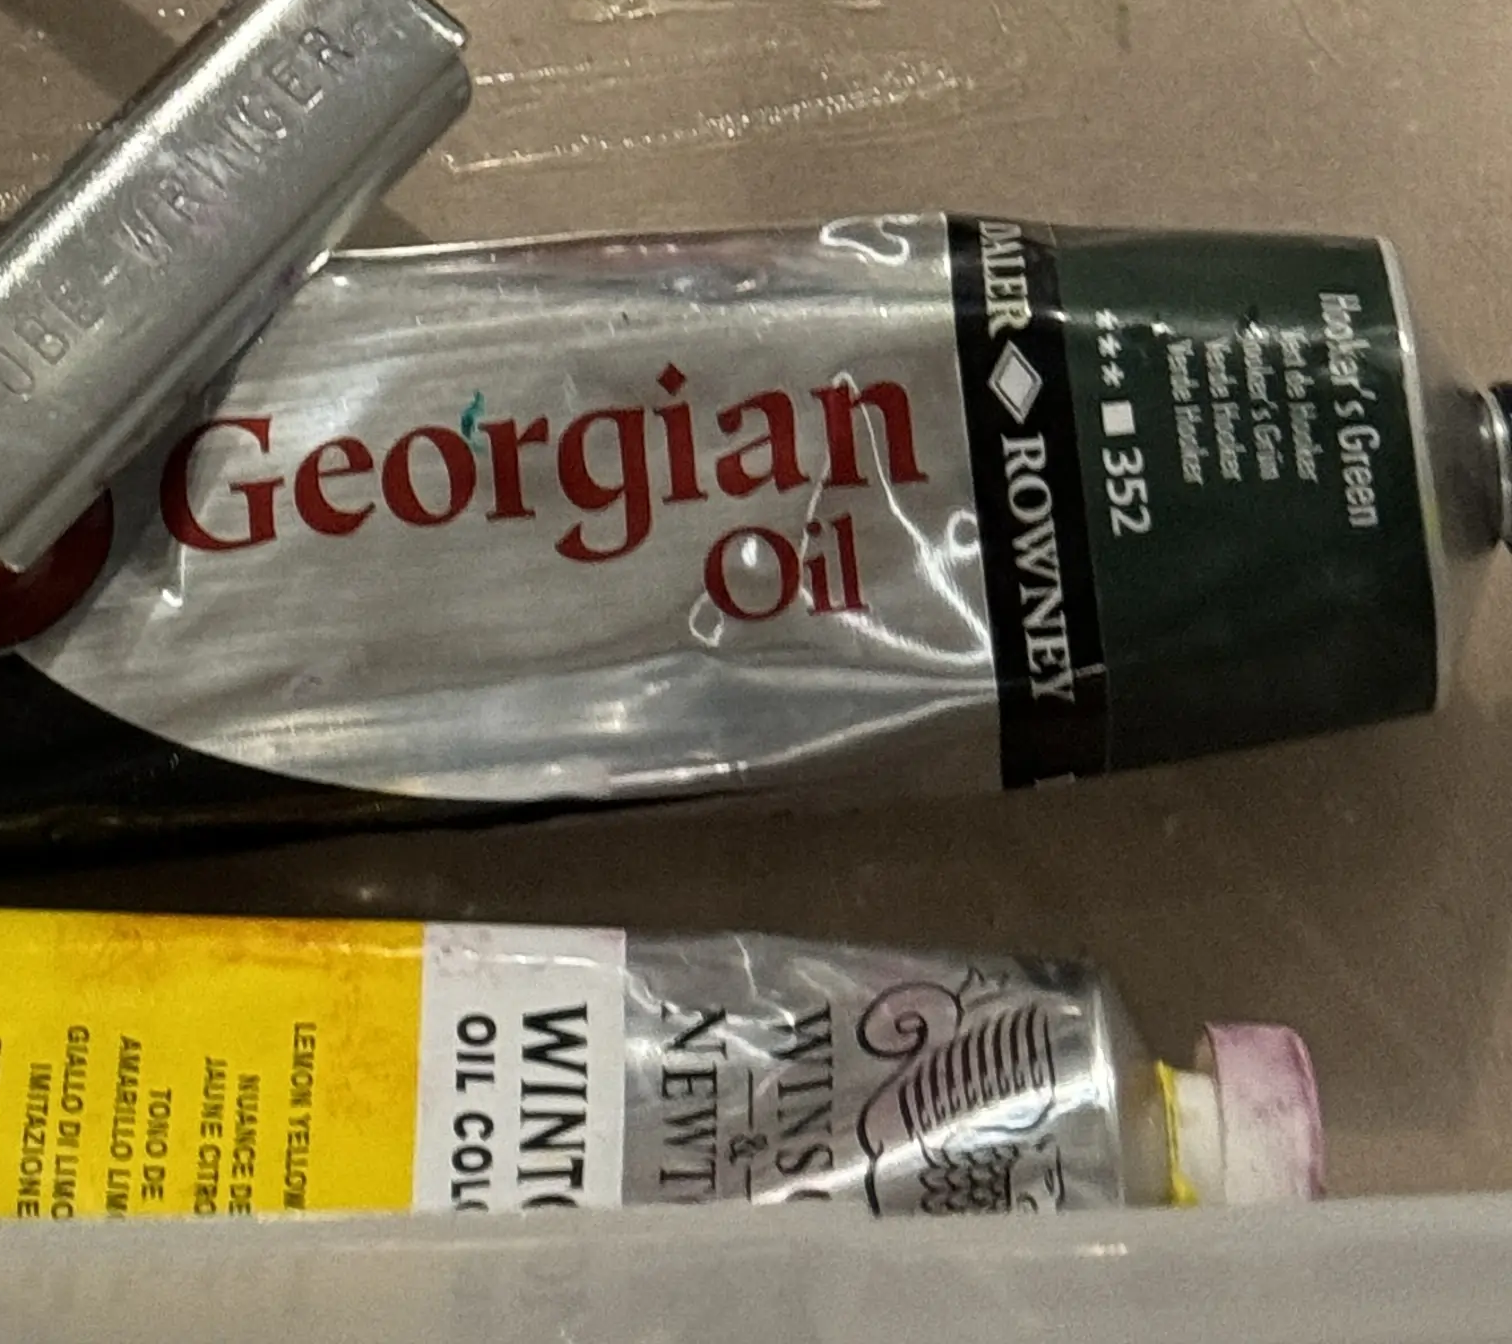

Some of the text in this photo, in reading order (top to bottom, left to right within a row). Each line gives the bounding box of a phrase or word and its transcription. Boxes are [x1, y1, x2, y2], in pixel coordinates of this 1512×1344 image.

[158, 362, 930, 564] Georgian
[1318, 291, 1381, 530] Hooker's Green
[1100, 445, 1153, 538] 352
[702, 513, 870, 622] Oil
[999, 431, 1077, 706] ROWNEY
[56, 1024, 91, 1149] GIALLO DI
[108, 1034, 143, 1163] AMARILLO
[198, 1055, 229, 1139] JAUNE
[454, 1013, 499, 1093] OIL
[15, 1062, 54, 1219] IMITAZIONE
[140, 1087, 173, 1204] TONO DE
[230, 1073, 262, 1178] NUANCE
[282, 1021, 318, 1211] LEMON YELLOW
